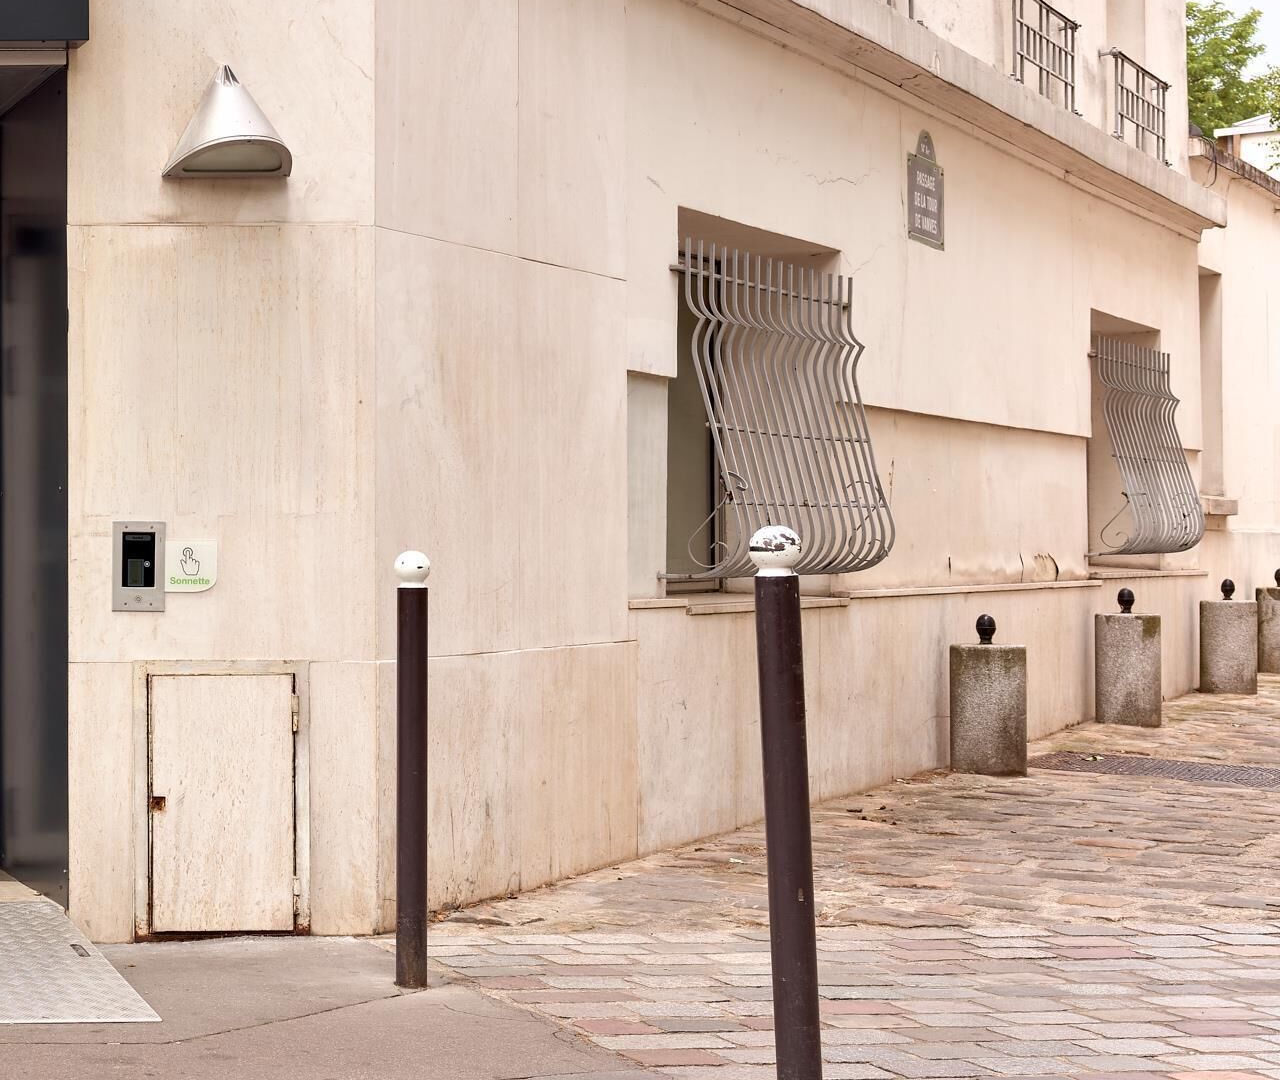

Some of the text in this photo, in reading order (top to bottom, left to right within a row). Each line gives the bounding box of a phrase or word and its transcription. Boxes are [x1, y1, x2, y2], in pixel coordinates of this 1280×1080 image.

[916, 170, 936, 192] PASSAGE
[914, 191, 938, 213] DE LA TOUR
[914, 213, 921, 229] DE
[169, 576, 210, 585] Sonnette
